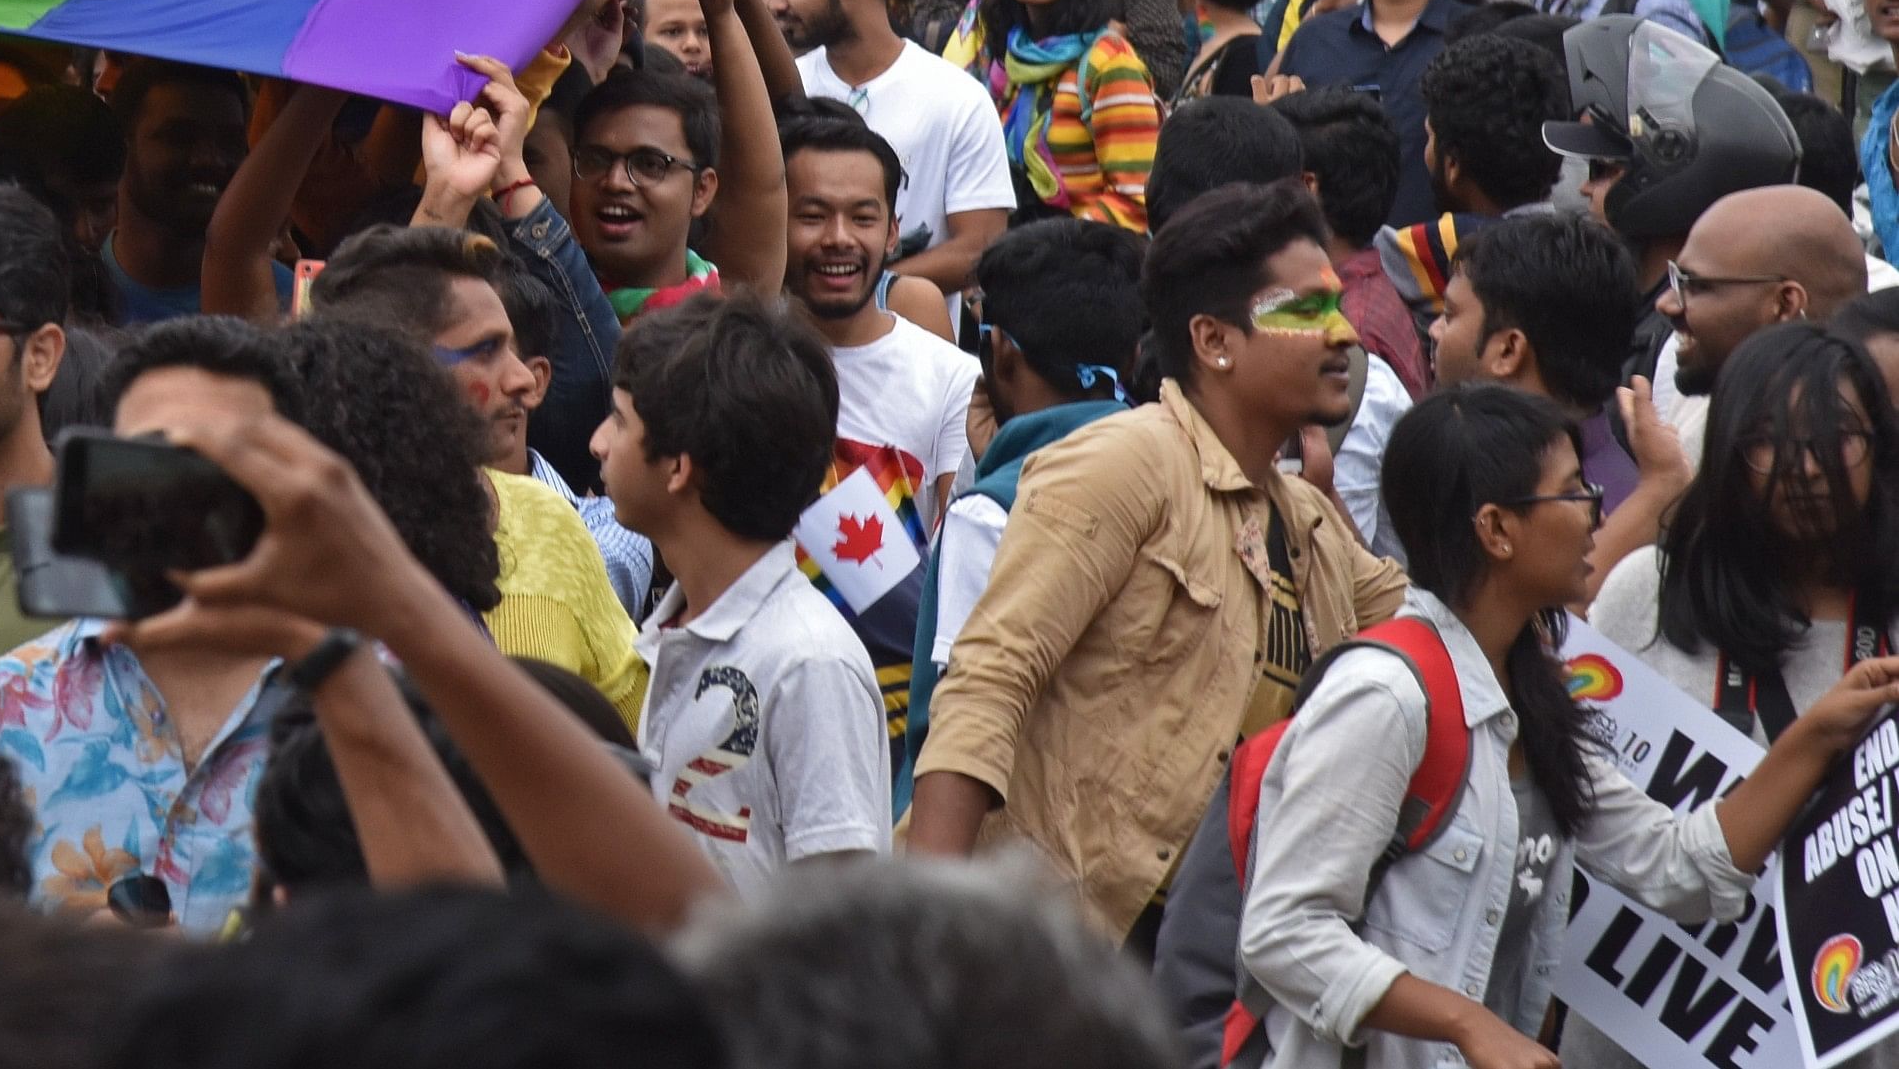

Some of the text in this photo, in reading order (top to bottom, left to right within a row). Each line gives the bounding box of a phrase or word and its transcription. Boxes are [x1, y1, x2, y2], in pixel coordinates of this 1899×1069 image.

[667, 665, 760, 844] 2
[1854, 717, 1899, 790] END
[1584, 904, 1778, 1069] LIVE
